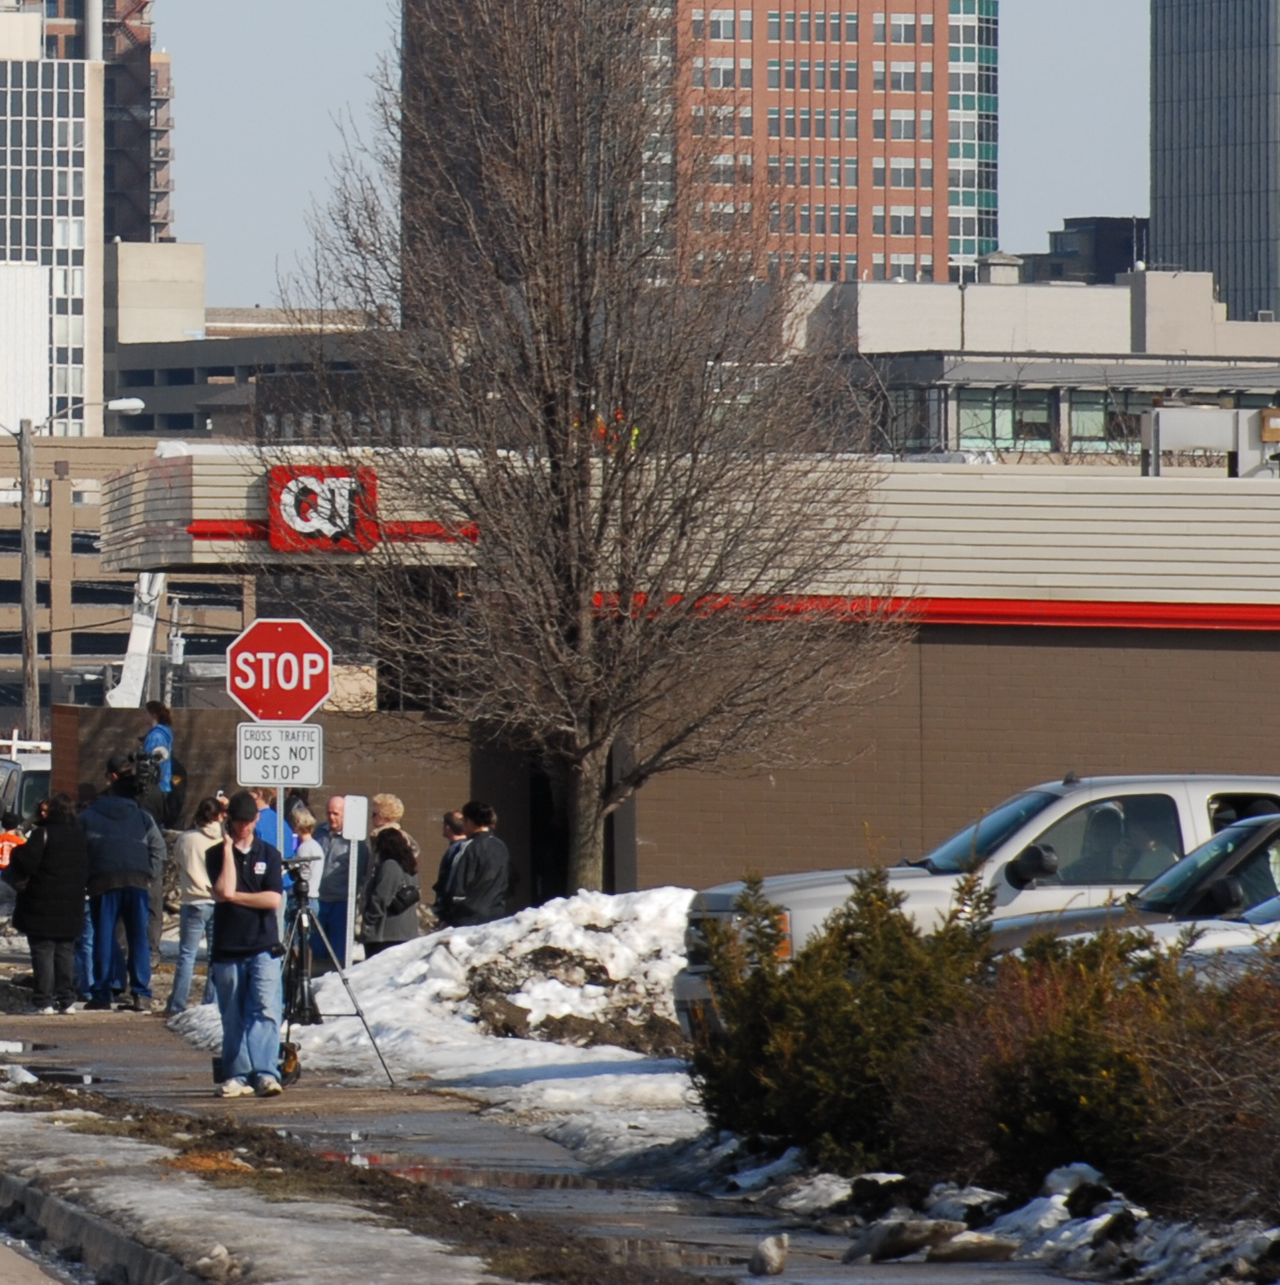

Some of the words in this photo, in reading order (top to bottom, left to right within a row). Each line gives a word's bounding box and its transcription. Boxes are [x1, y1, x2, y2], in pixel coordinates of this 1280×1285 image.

[280, 476, 356, 538] QT
[234, 651, 325, 691] STOP
[244, 730, 272, 742] CROSS
[278, 730, 315, 742] TRAFFIC
[244, 745, 280, 760] DOES
[289, 746, 315, 761] NOT
[261, 764, 300, 780] STOP
